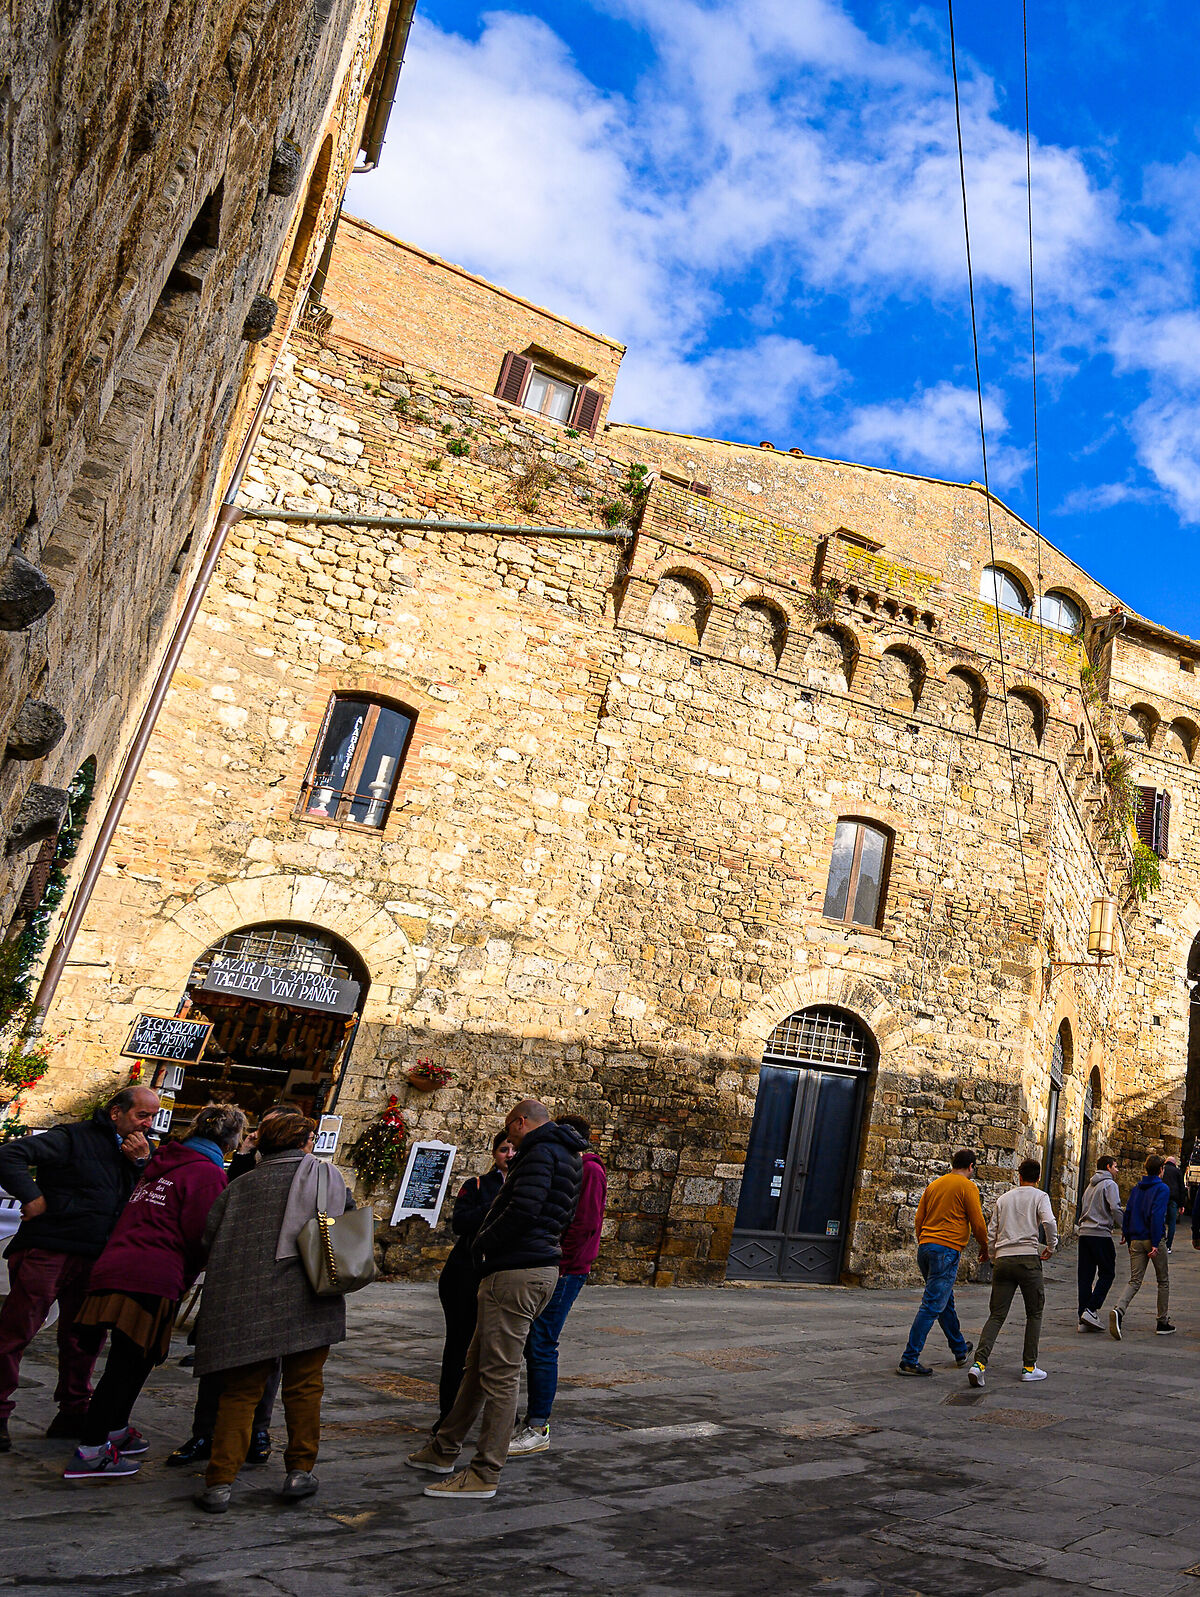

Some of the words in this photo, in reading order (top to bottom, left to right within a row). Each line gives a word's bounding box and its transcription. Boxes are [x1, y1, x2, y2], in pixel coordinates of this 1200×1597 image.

[340, 716, 363, 778] ALABASTRI
[212, 957, 256, 975] BAZAR
[261, 965, 287, 981] DEI
[288, 971, 338, 990] SAPORI
[213, 970, 265, 992] TAGLIERI
[271, 980, 299, 998] VINI
[298, 985, 340, 1005] PANINI
[135, 1029, 160, 1043] WINE
[160, 1032, 197, 1049] TASTING
[137, 1016, 209, 1038] DEGUSTAZIONI
[136, 1041, 188, 1059] TAGLIERI
